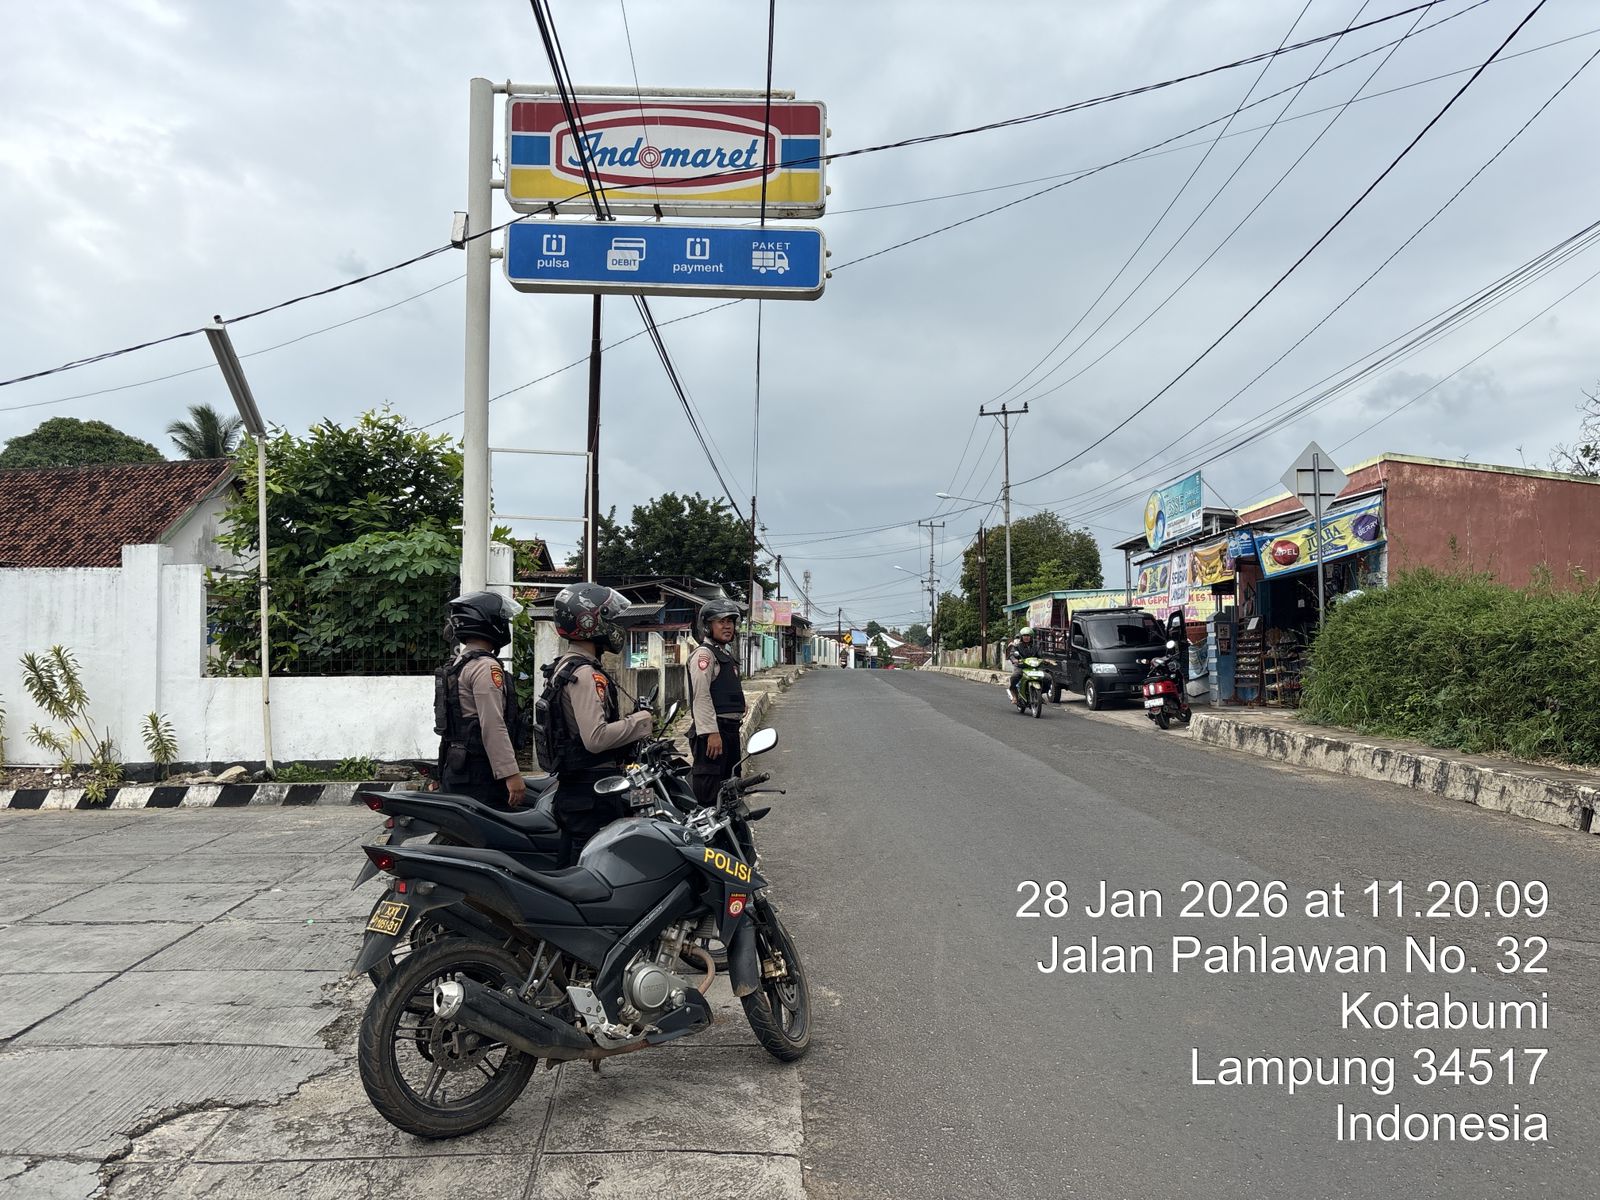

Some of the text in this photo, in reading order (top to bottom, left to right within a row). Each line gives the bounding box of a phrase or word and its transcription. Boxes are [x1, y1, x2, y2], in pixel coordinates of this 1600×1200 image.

[568, 131, 758, 169] Indomaret
[752, 241, 791, 250] PAKET
[537, 258, 570, 270] pulsa
[611, 258, 638, 267] DEBIT
[673, 262, 724, 273] payment
[1357, 519, 1379, 537] BERRY
[1260, 539, 1271, 553] NEW
[704, 848, 752, 883] POLISI
